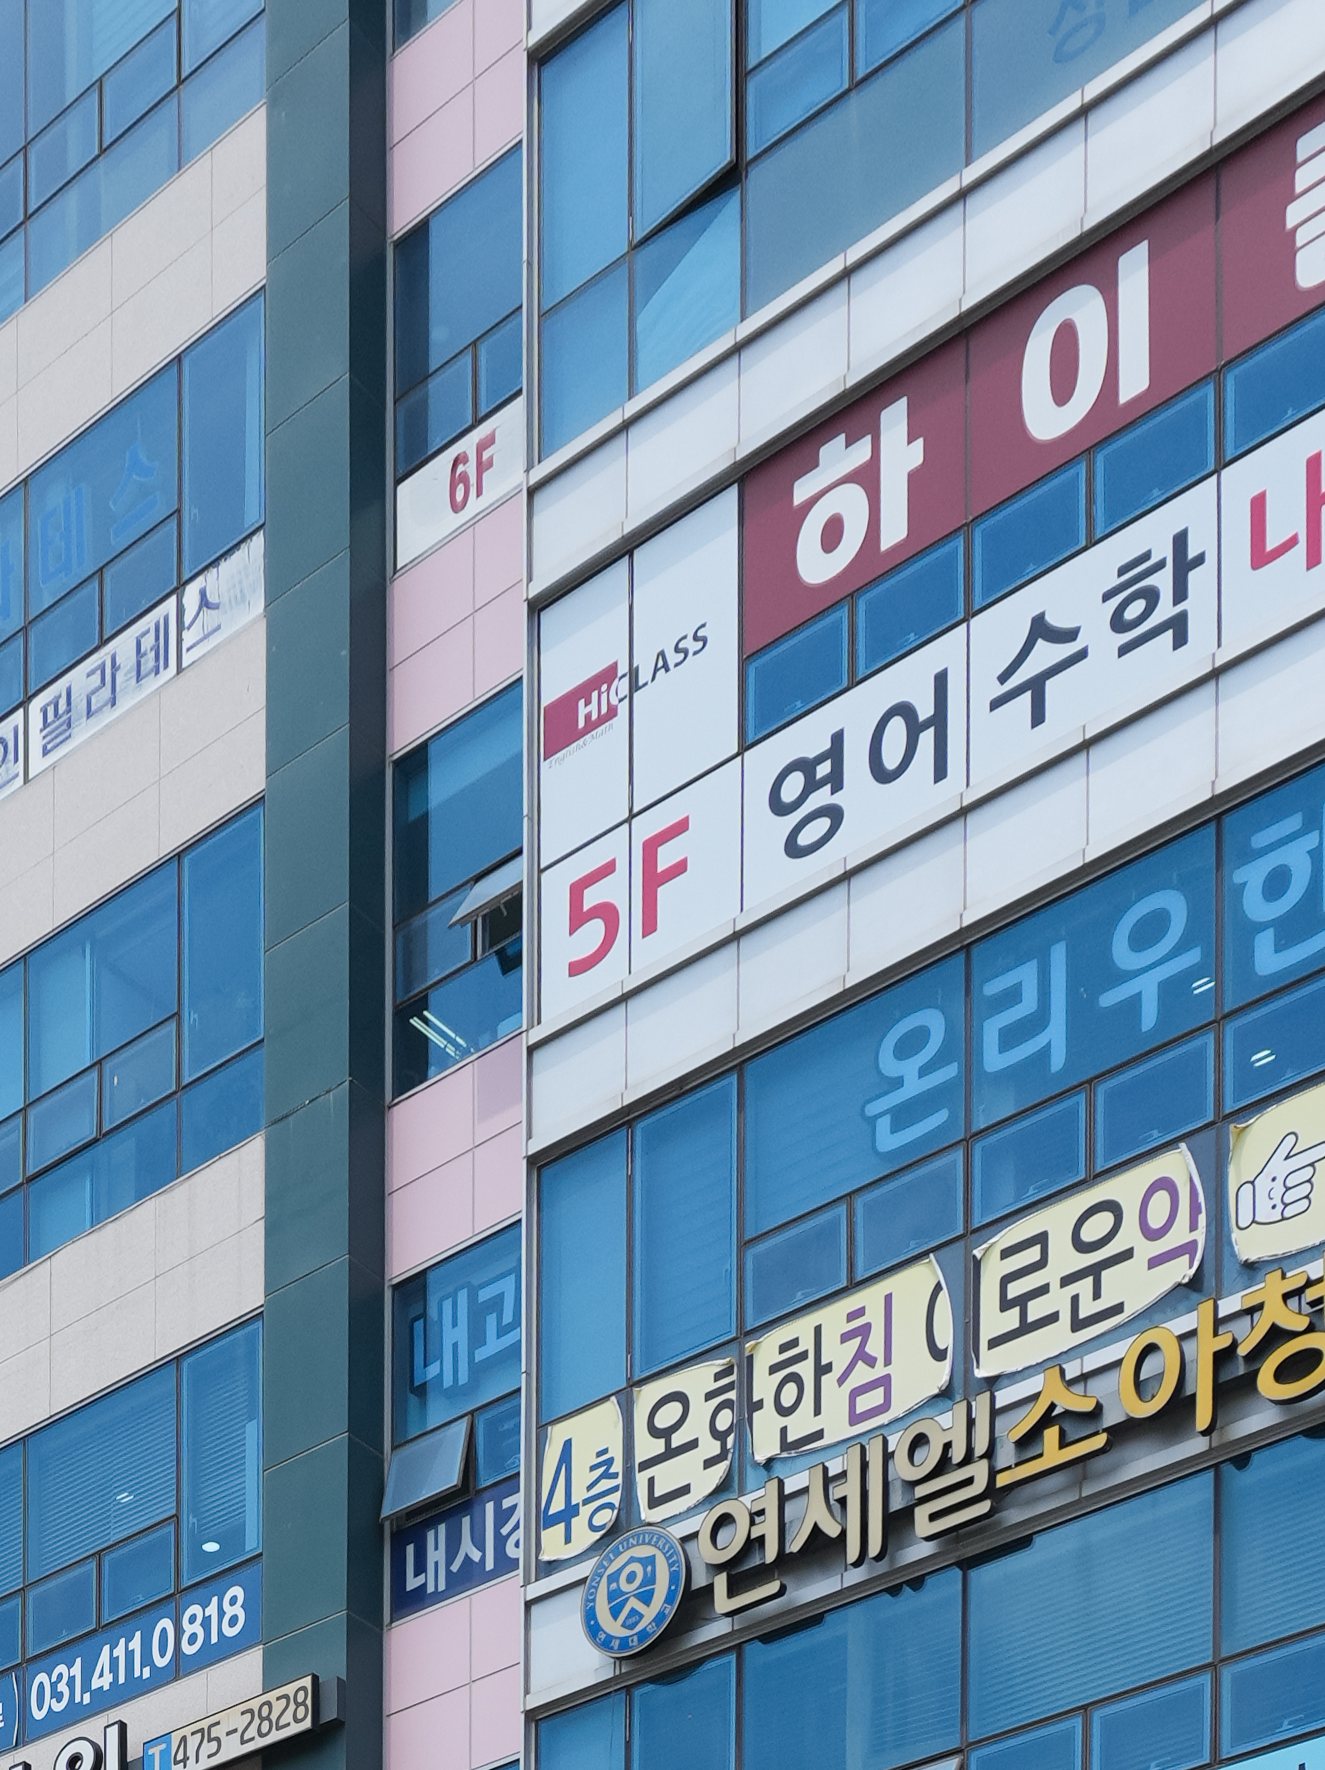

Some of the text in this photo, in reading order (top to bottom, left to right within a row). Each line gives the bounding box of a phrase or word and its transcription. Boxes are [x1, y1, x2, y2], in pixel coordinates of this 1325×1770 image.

[448, 427, 498, 515] 6F
[568, 814, 690, 978] 5F
[542, 1437, 621, 1545] 4층
[619, 1532, 680, 1575] UNIVERSITY
[30, 1584, 246, 1722] 031.411.0818
[172, 1685, 310, 1770] 475-2828
